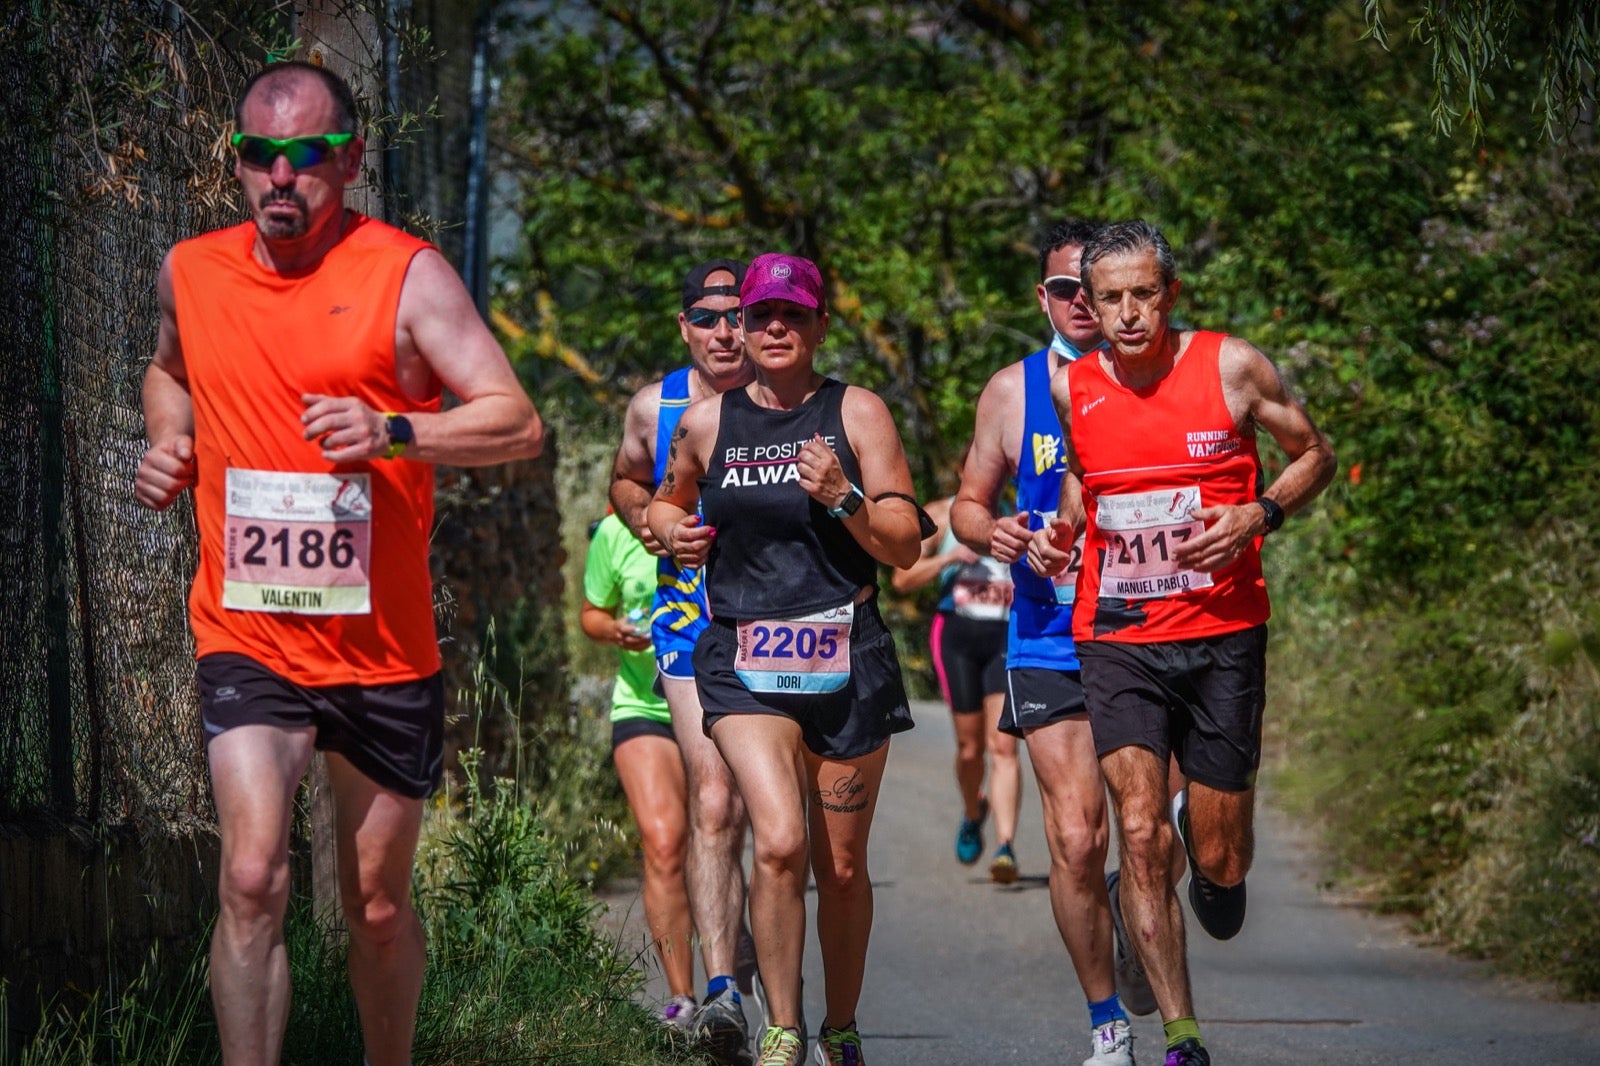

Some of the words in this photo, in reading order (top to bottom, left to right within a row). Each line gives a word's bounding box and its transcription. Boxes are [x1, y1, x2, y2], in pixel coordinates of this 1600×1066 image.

[1186, 430, 1228, 442] RUNNING
[725, 447, 749, 463] BE
[754, 436, 836, 460] POSITE
[243, 525, 355, 569] 2186
[1117, 580, 1155, 594] MANUEL
[1157, 574, 1190, 593] PABLO
[261, 588, 322, 608] VALENTIN
[741, 636, 749, 661] MASTER
[752, 626, 838, 659] 2205
[776, 675, 801, 689] DORI
